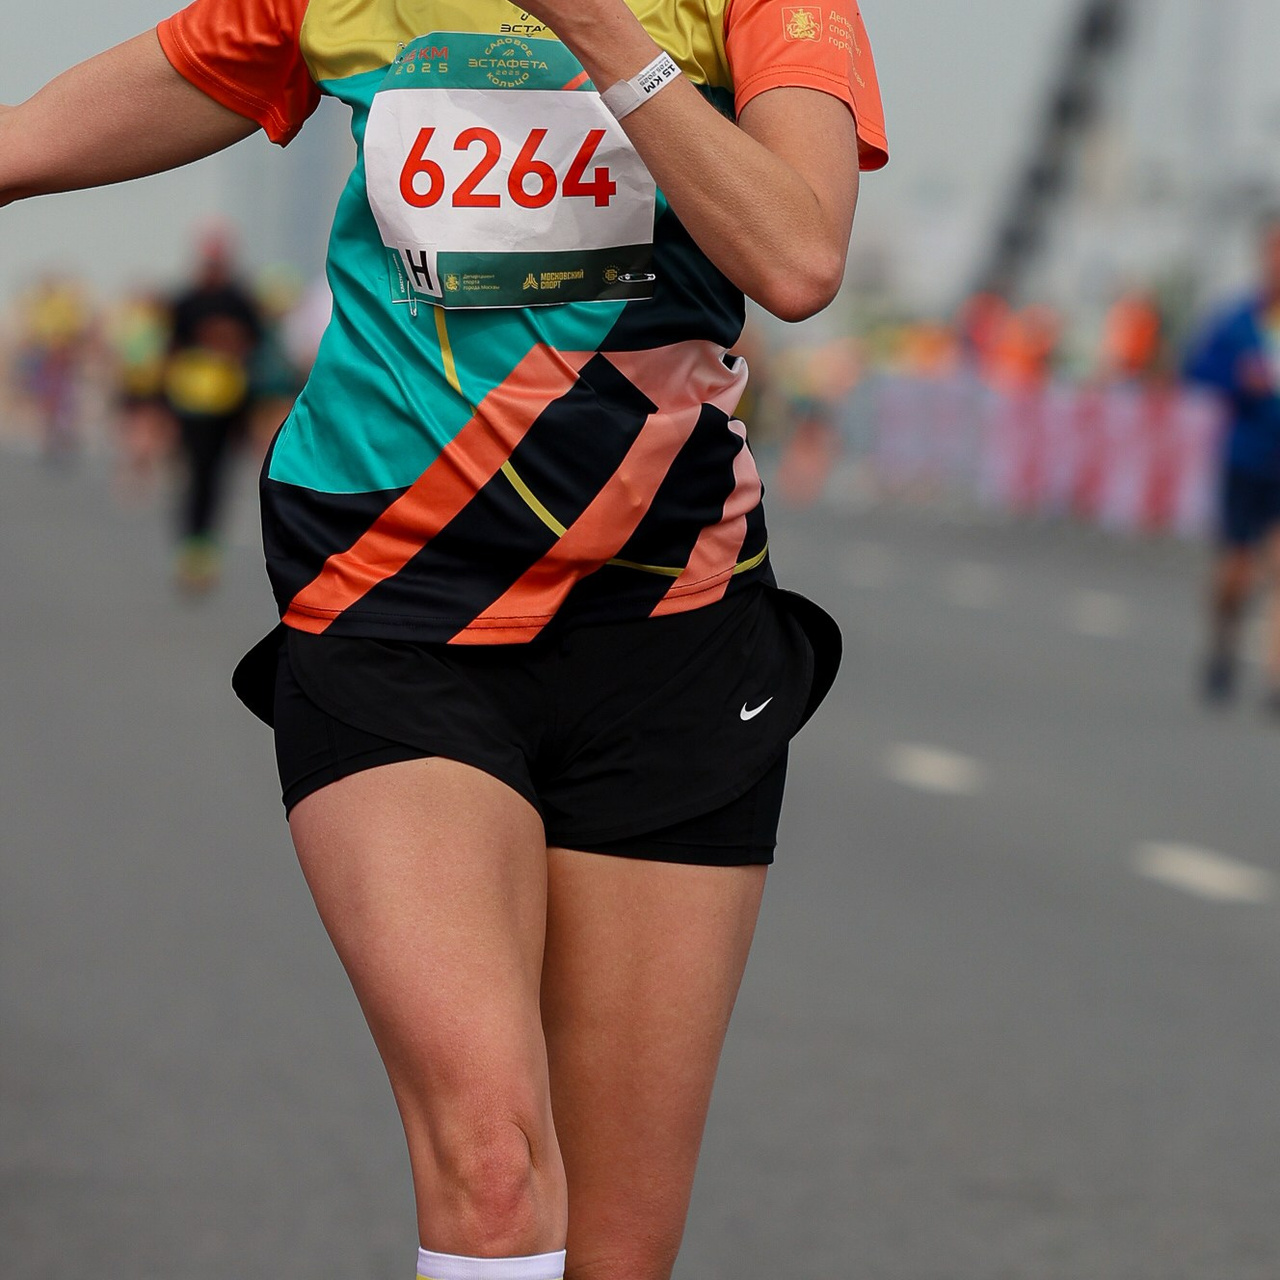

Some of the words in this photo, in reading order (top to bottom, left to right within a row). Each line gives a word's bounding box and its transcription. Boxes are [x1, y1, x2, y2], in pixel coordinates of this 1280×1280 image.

[484, 37, 533, 58] САДОВОЕ
[395, 61, 449, 76] 2025
[467, 58, 549, 70] ЭСТАФЕТА
[661, 63, 676, 79] 15
[486, 71, 530, 88] КОЛЬЦО
[399, 126, 617, 209] 6264
[540, 269, 584, 281] МОСКОВСКИЙ
[540, 280, 562, 290] СПОРТ
